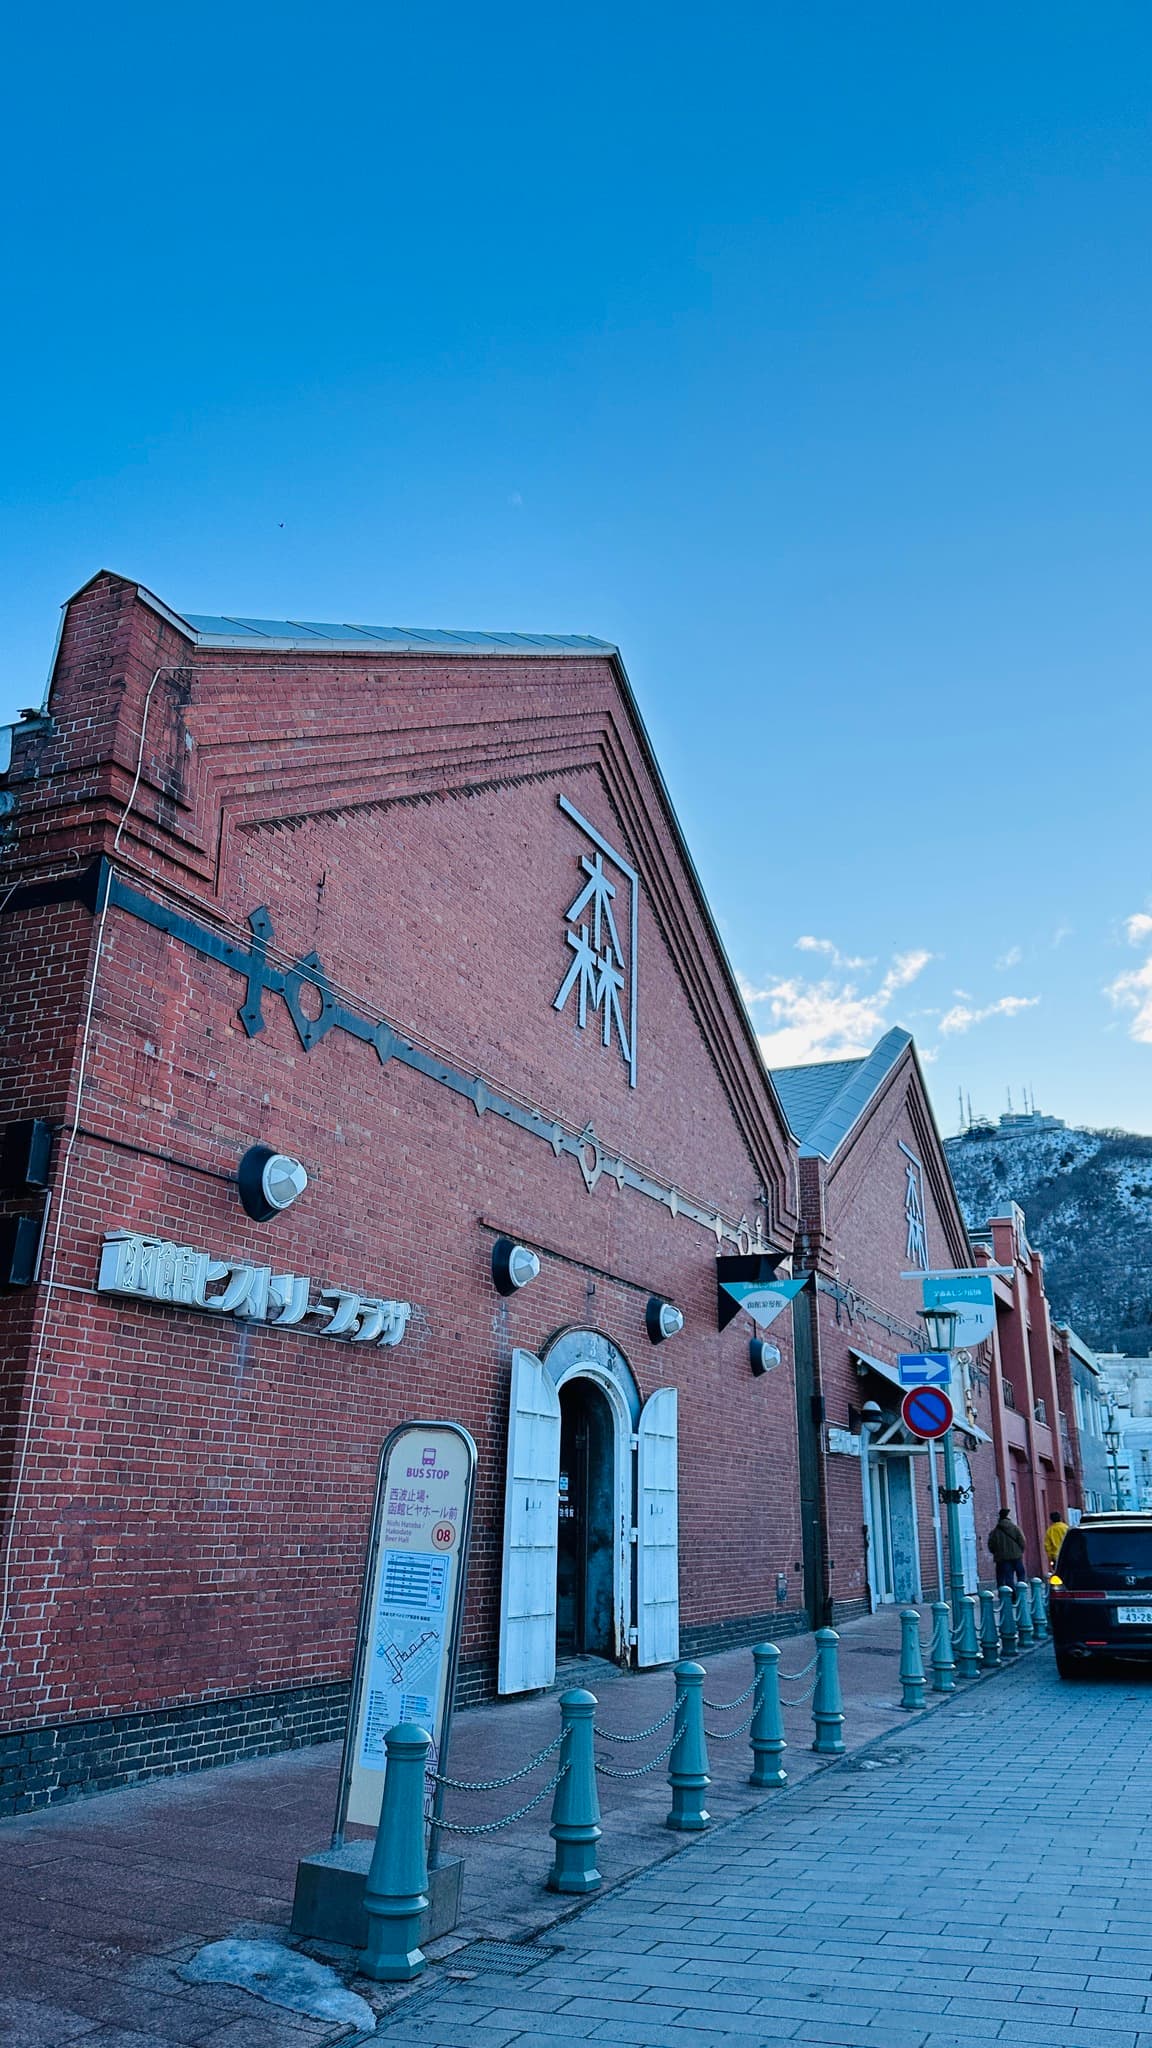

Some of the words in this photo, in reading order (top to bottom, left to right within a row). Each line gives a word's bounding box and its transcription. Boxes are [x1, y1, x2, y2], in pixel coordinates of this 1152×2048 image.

[406, 1467, 424, 1478] BUS
[425, 1469, 450, 1480] STOP
[436, 1529, 451, 1542] 08
